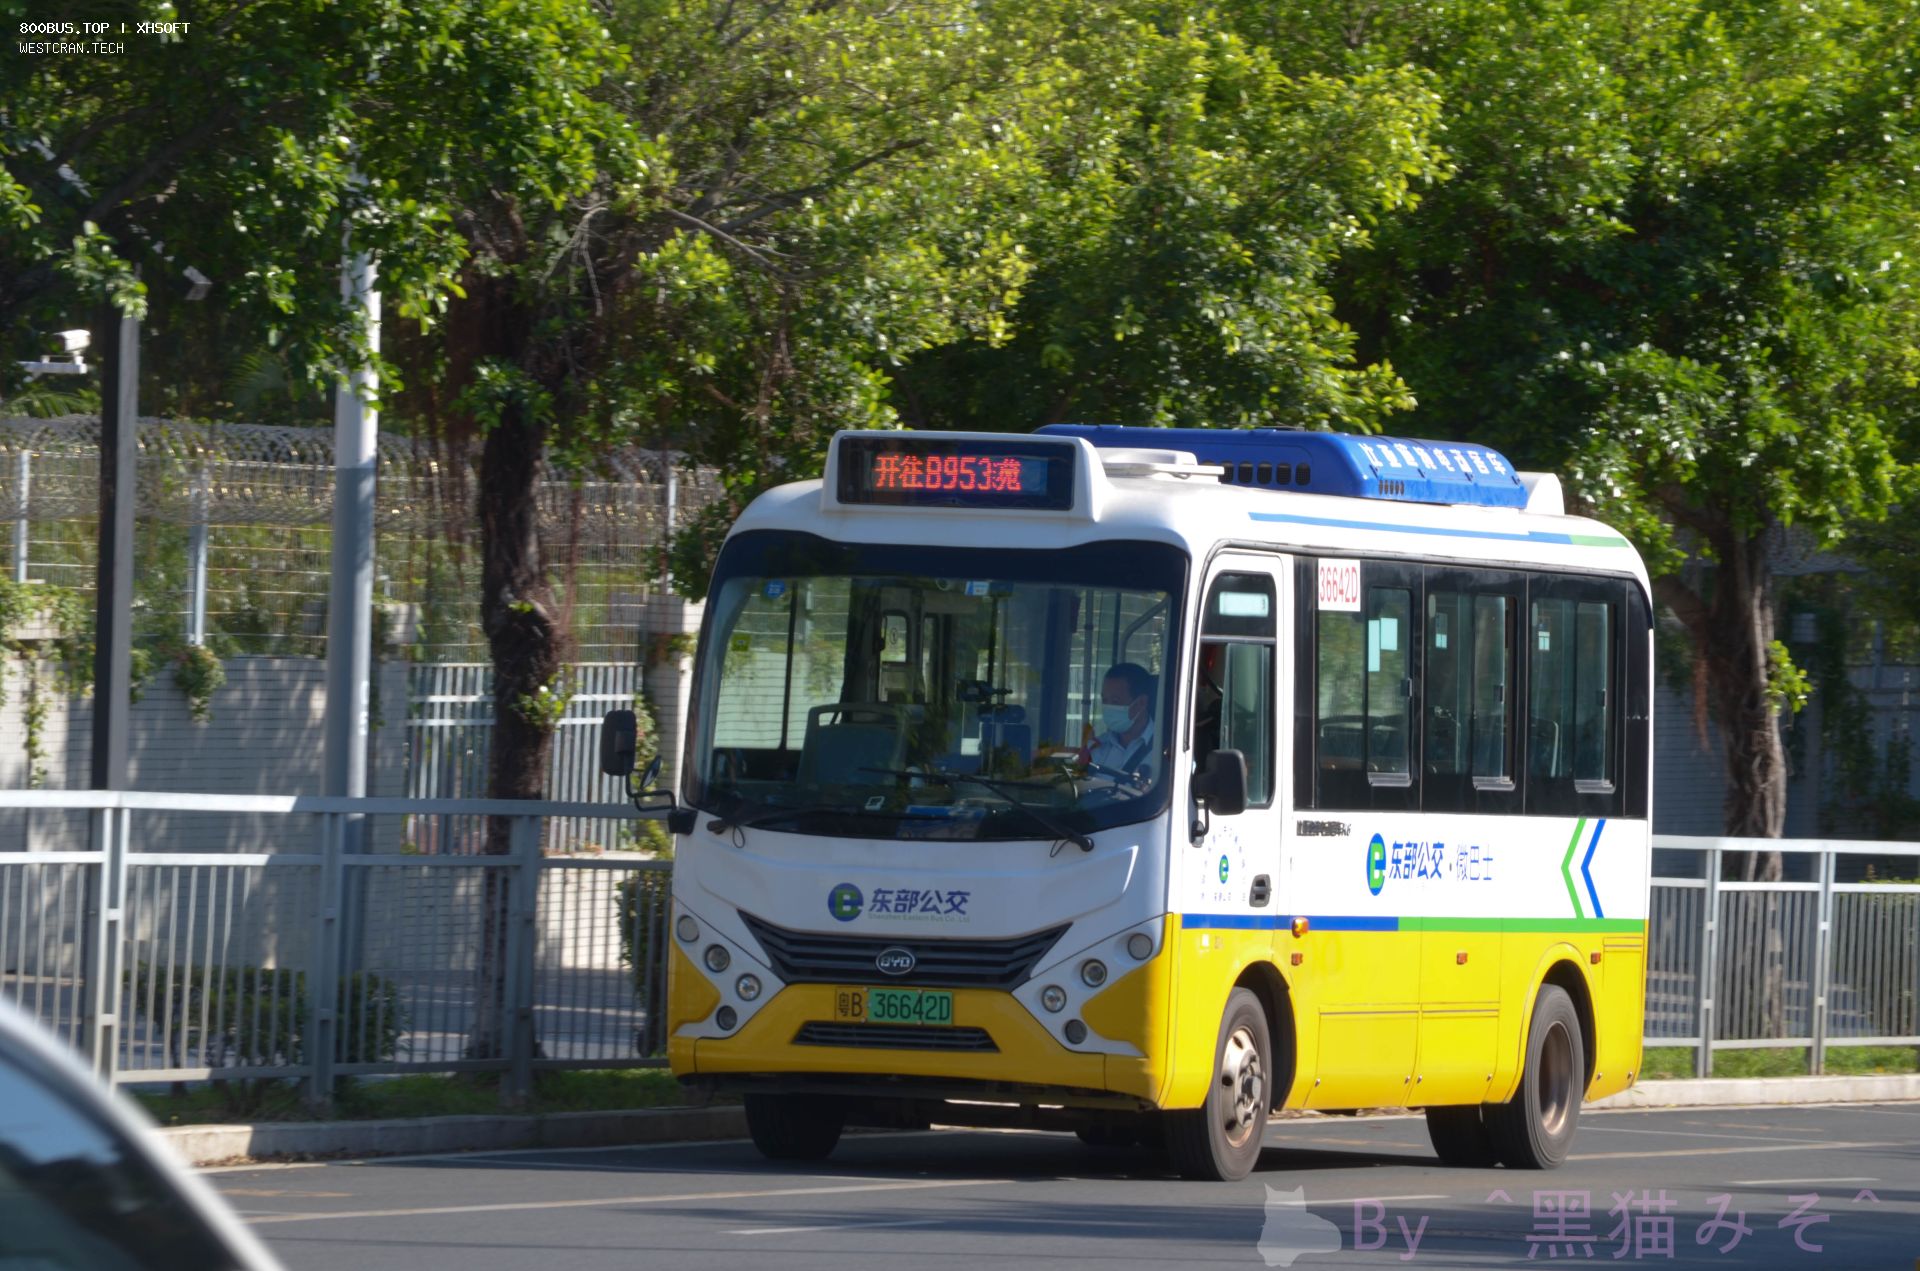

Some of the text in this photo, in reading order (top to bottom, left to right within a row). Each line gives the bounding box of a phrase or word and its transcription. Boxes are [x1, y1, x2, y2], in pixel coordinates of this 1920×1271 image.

[1319, 566, 1358, 603] 36642D
[868, 888, 970, 915] 东部公交
[880, 956, 911, 967] BYD
[838, 992, 951, 1021] 粤B 36642D
